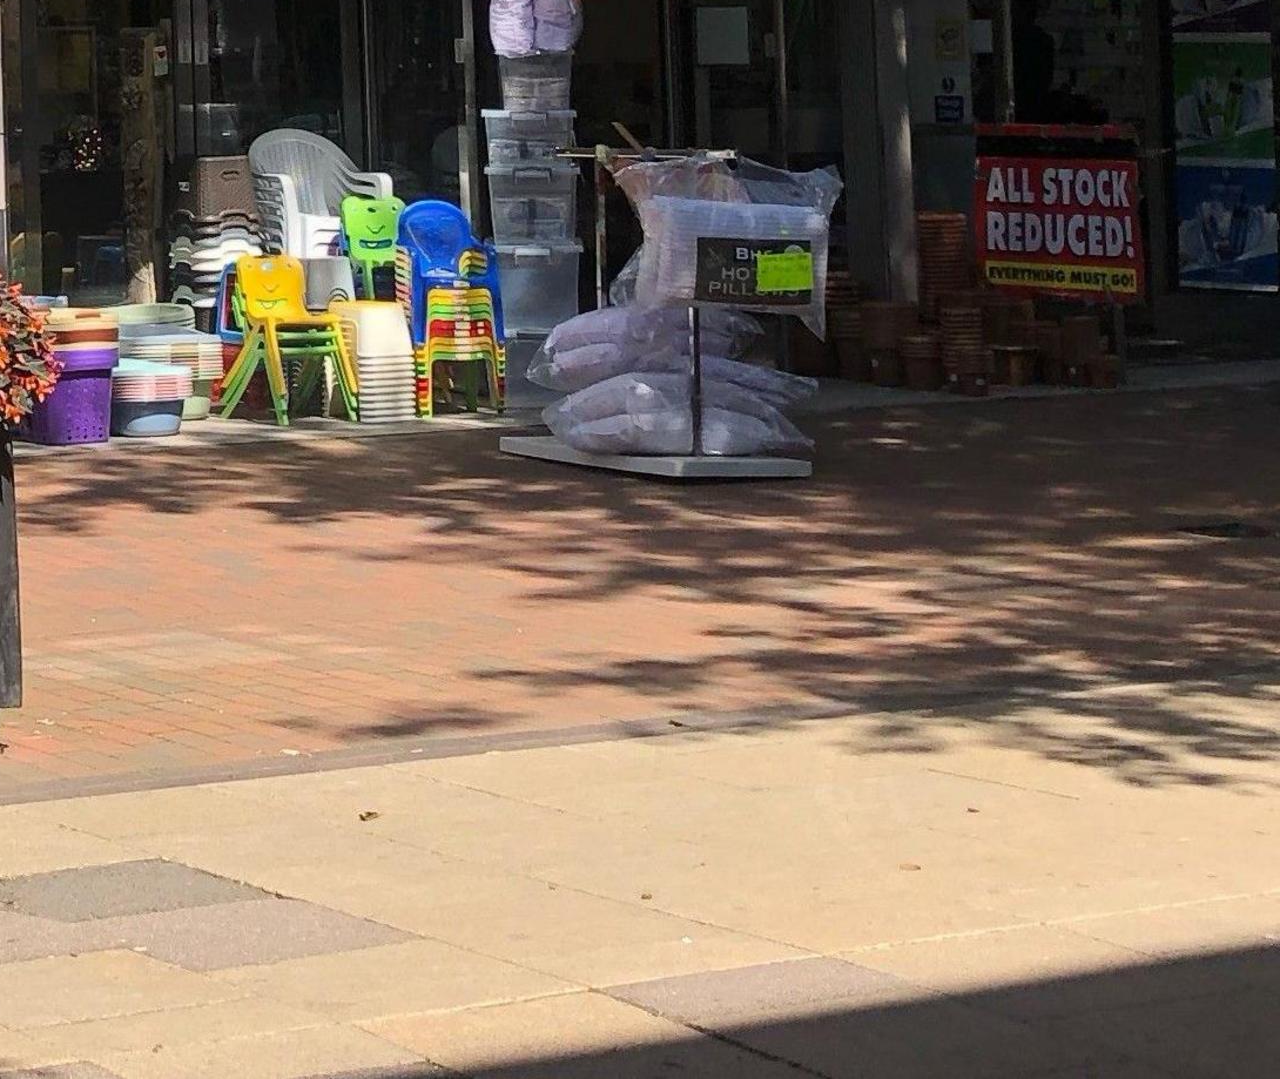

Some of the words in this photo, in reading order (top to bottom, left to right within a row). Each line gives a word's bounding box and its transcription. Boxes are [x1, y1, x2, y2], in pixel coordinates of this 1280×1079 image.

[986, 167, 1035, 204] ALL
[1042, 168, 1131, 208] STOCK
[986, 210, 1135, 259] REDUCED!
[989, 266, 1066, 283] EVERYTHING
[1070, 271, 1106, 287] MUST
[1111, 274, 1134, 287] GO!
